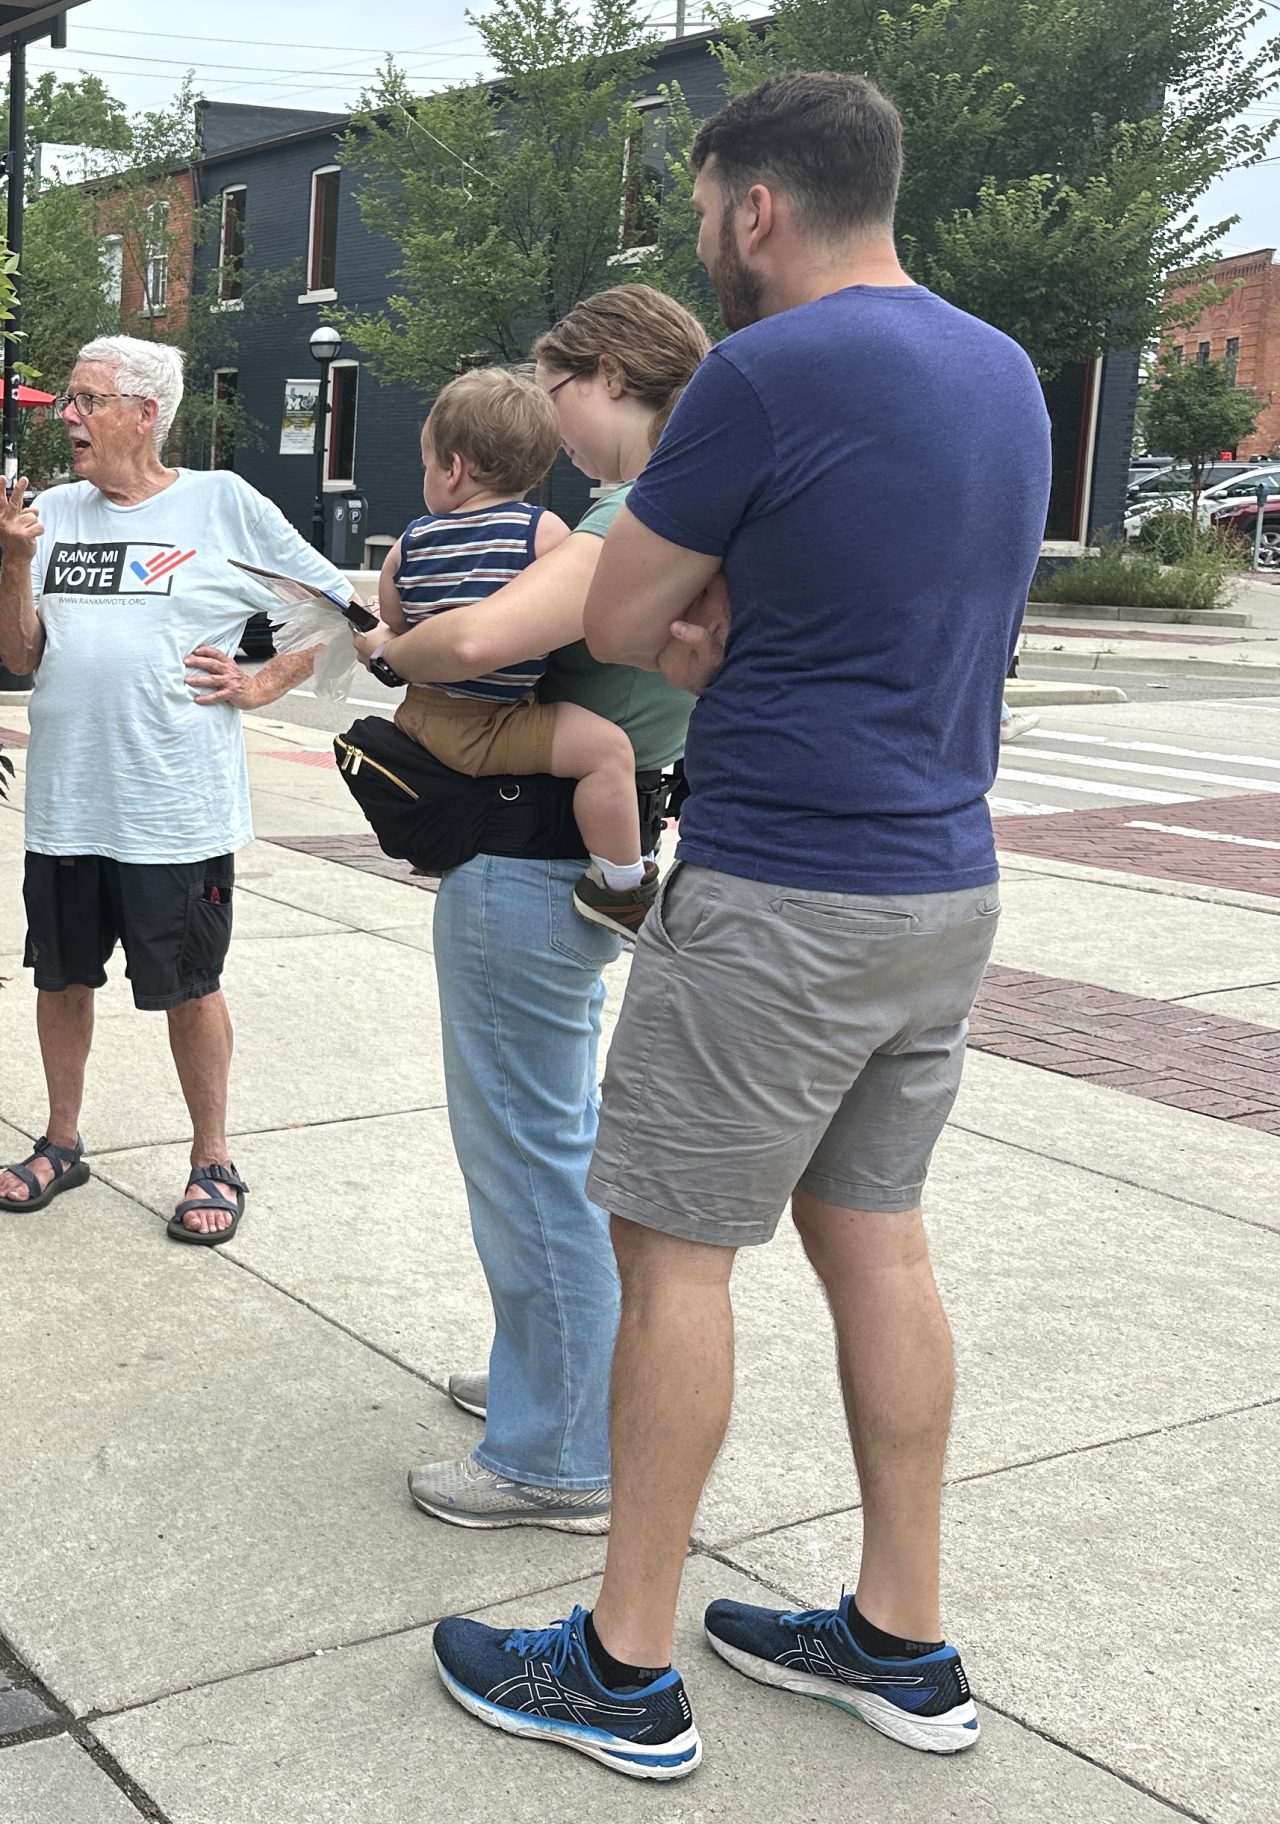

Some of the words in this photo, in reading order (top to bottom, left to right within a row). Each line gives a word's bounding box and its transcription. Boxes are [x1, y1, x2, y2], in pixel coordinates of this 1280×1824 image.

[57, 550, 97, 564] RANK
[100, 550, 119, 563] MI
[54, 566, 115, 587] VOTE
[58, 597, 147, 606] WWW.RANKMIVOTE.ORG
